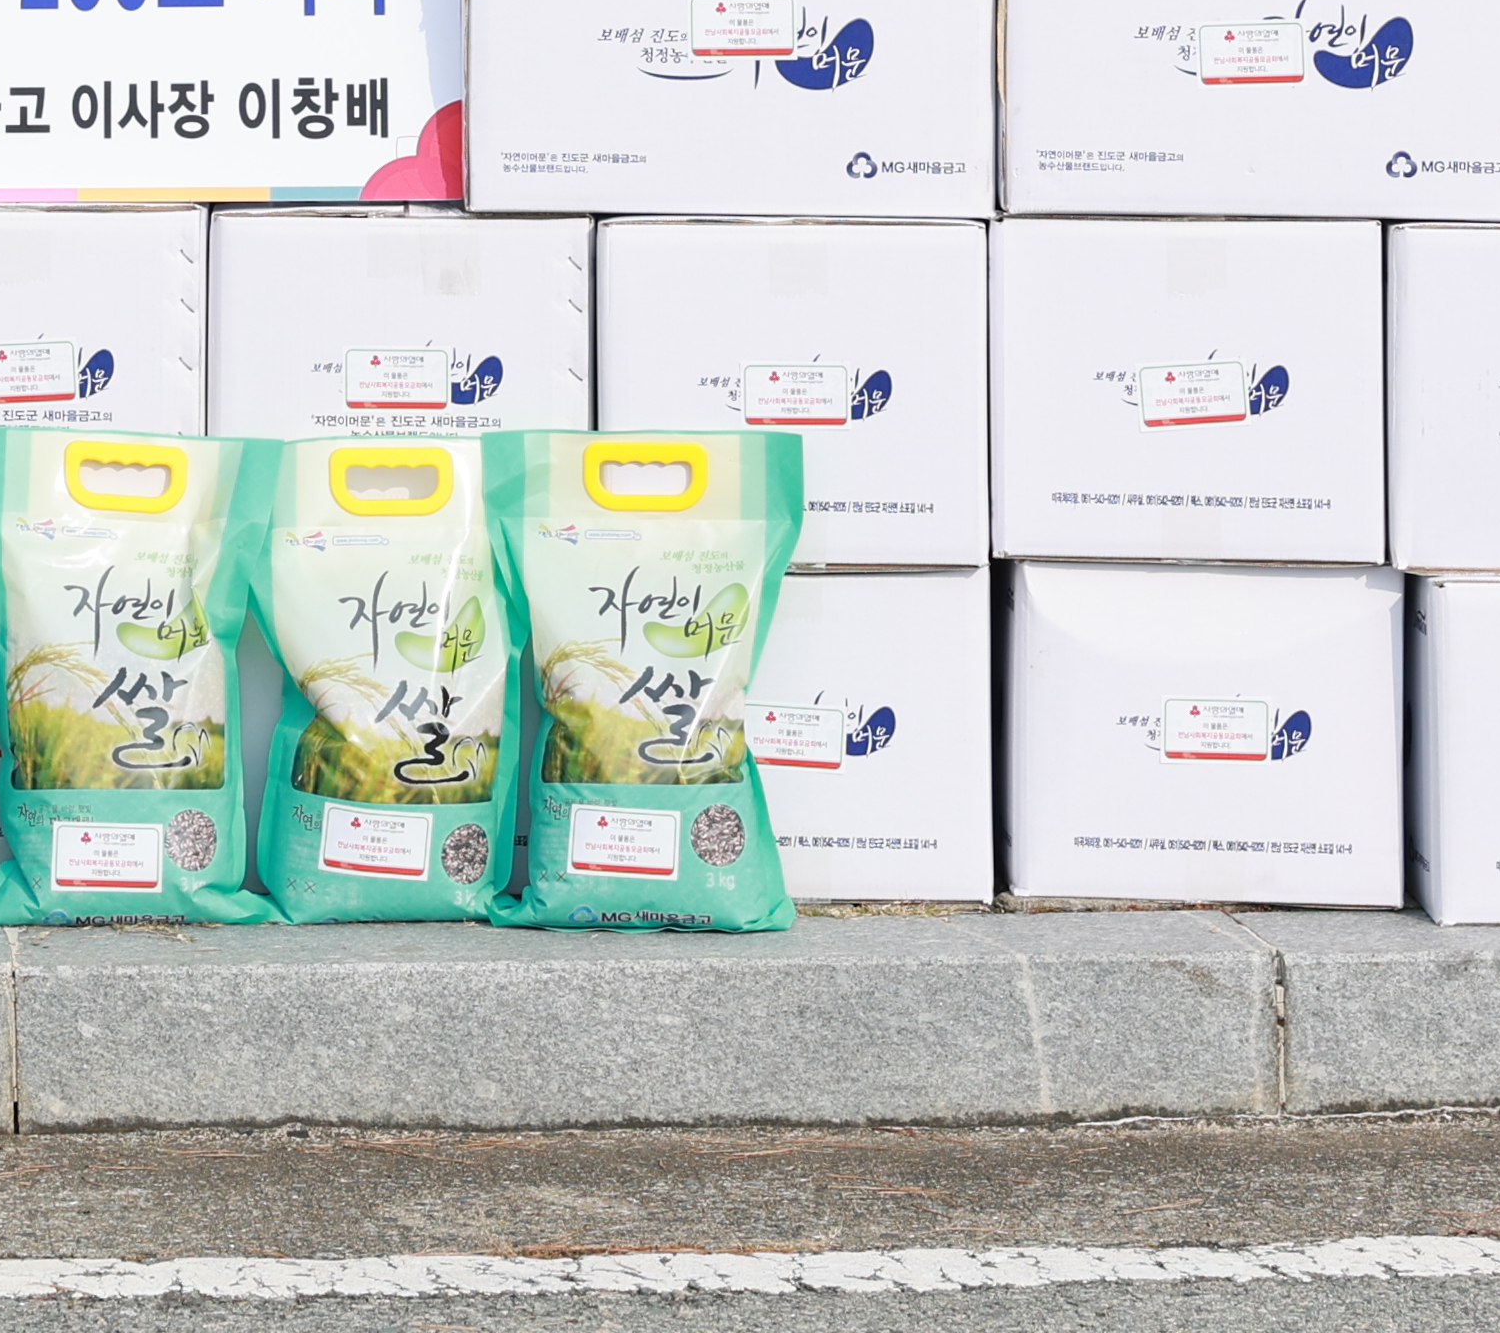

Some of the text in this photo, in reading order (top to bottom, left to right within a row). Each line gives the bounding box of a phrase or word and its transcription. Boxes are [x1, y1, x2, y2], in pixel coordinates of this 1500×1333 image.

[598, 28, 644, 43] 보배섬
[1352, 44, 1405, 91] 머문
[71, 77, 215, 139] 이사장
[238, 73, 390, 137] 이창배
[503, 164, 587, 173] 농수산물브랜드입니다.
[561, 152, 589, 163] 진도군
[592, 153, 647, 164] 새마을금고의
[1039, 162, 1124, 171] 농수산물브랜드입니다.
[1097, 150, 1126, 162] 진도군
[1129, 151, 1183, 163] 새마을금고의
[3, 410, 37, 421] 진도군
[41, 410, 112, 423] 새마을금고의
[64, 565, 175, 660] 자연이
[589, 565, 740, 661] 자연이 머문
[93, 667, 188, 770] 쌀
[619, 666, 714, 765] 쌀
[375, 680, 463, 784] 쌀
[706, 871, 735, 889] 3 kg
